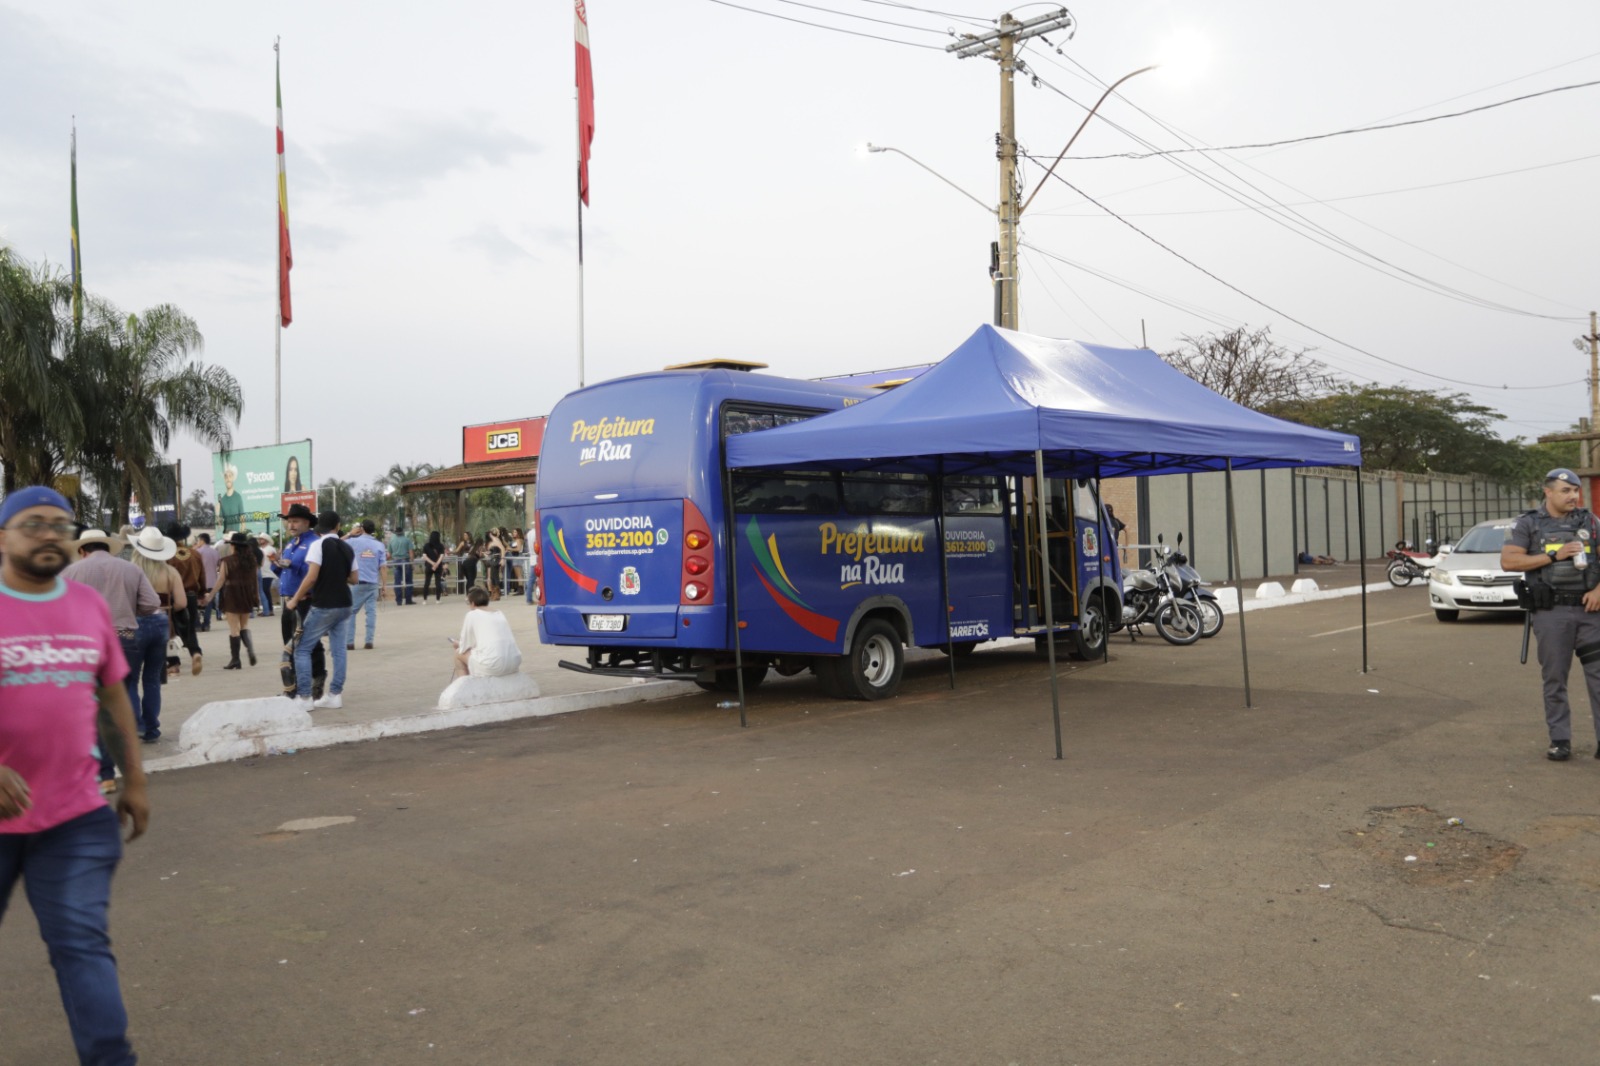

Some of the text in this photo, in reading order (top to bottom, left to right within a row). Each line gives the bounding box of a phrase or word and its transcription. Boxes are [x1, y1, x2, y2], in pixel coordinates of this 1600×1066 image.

[570, 416, 655, 446] Prefeitura
[488, 432, 519, 450] JCB
[580, 439, 632, 462] na Rua
[585, 515, 653, 532] OUVIDORIA
[586, 530, 654, 549] 3612-2100
[818, 521, 925, 562] Prefeitura
[945, 530, 986, 540] OUVIDORIA
[945, 541, 986, 552] 3612-2100
[840, 555, 905, 585] na Rua
